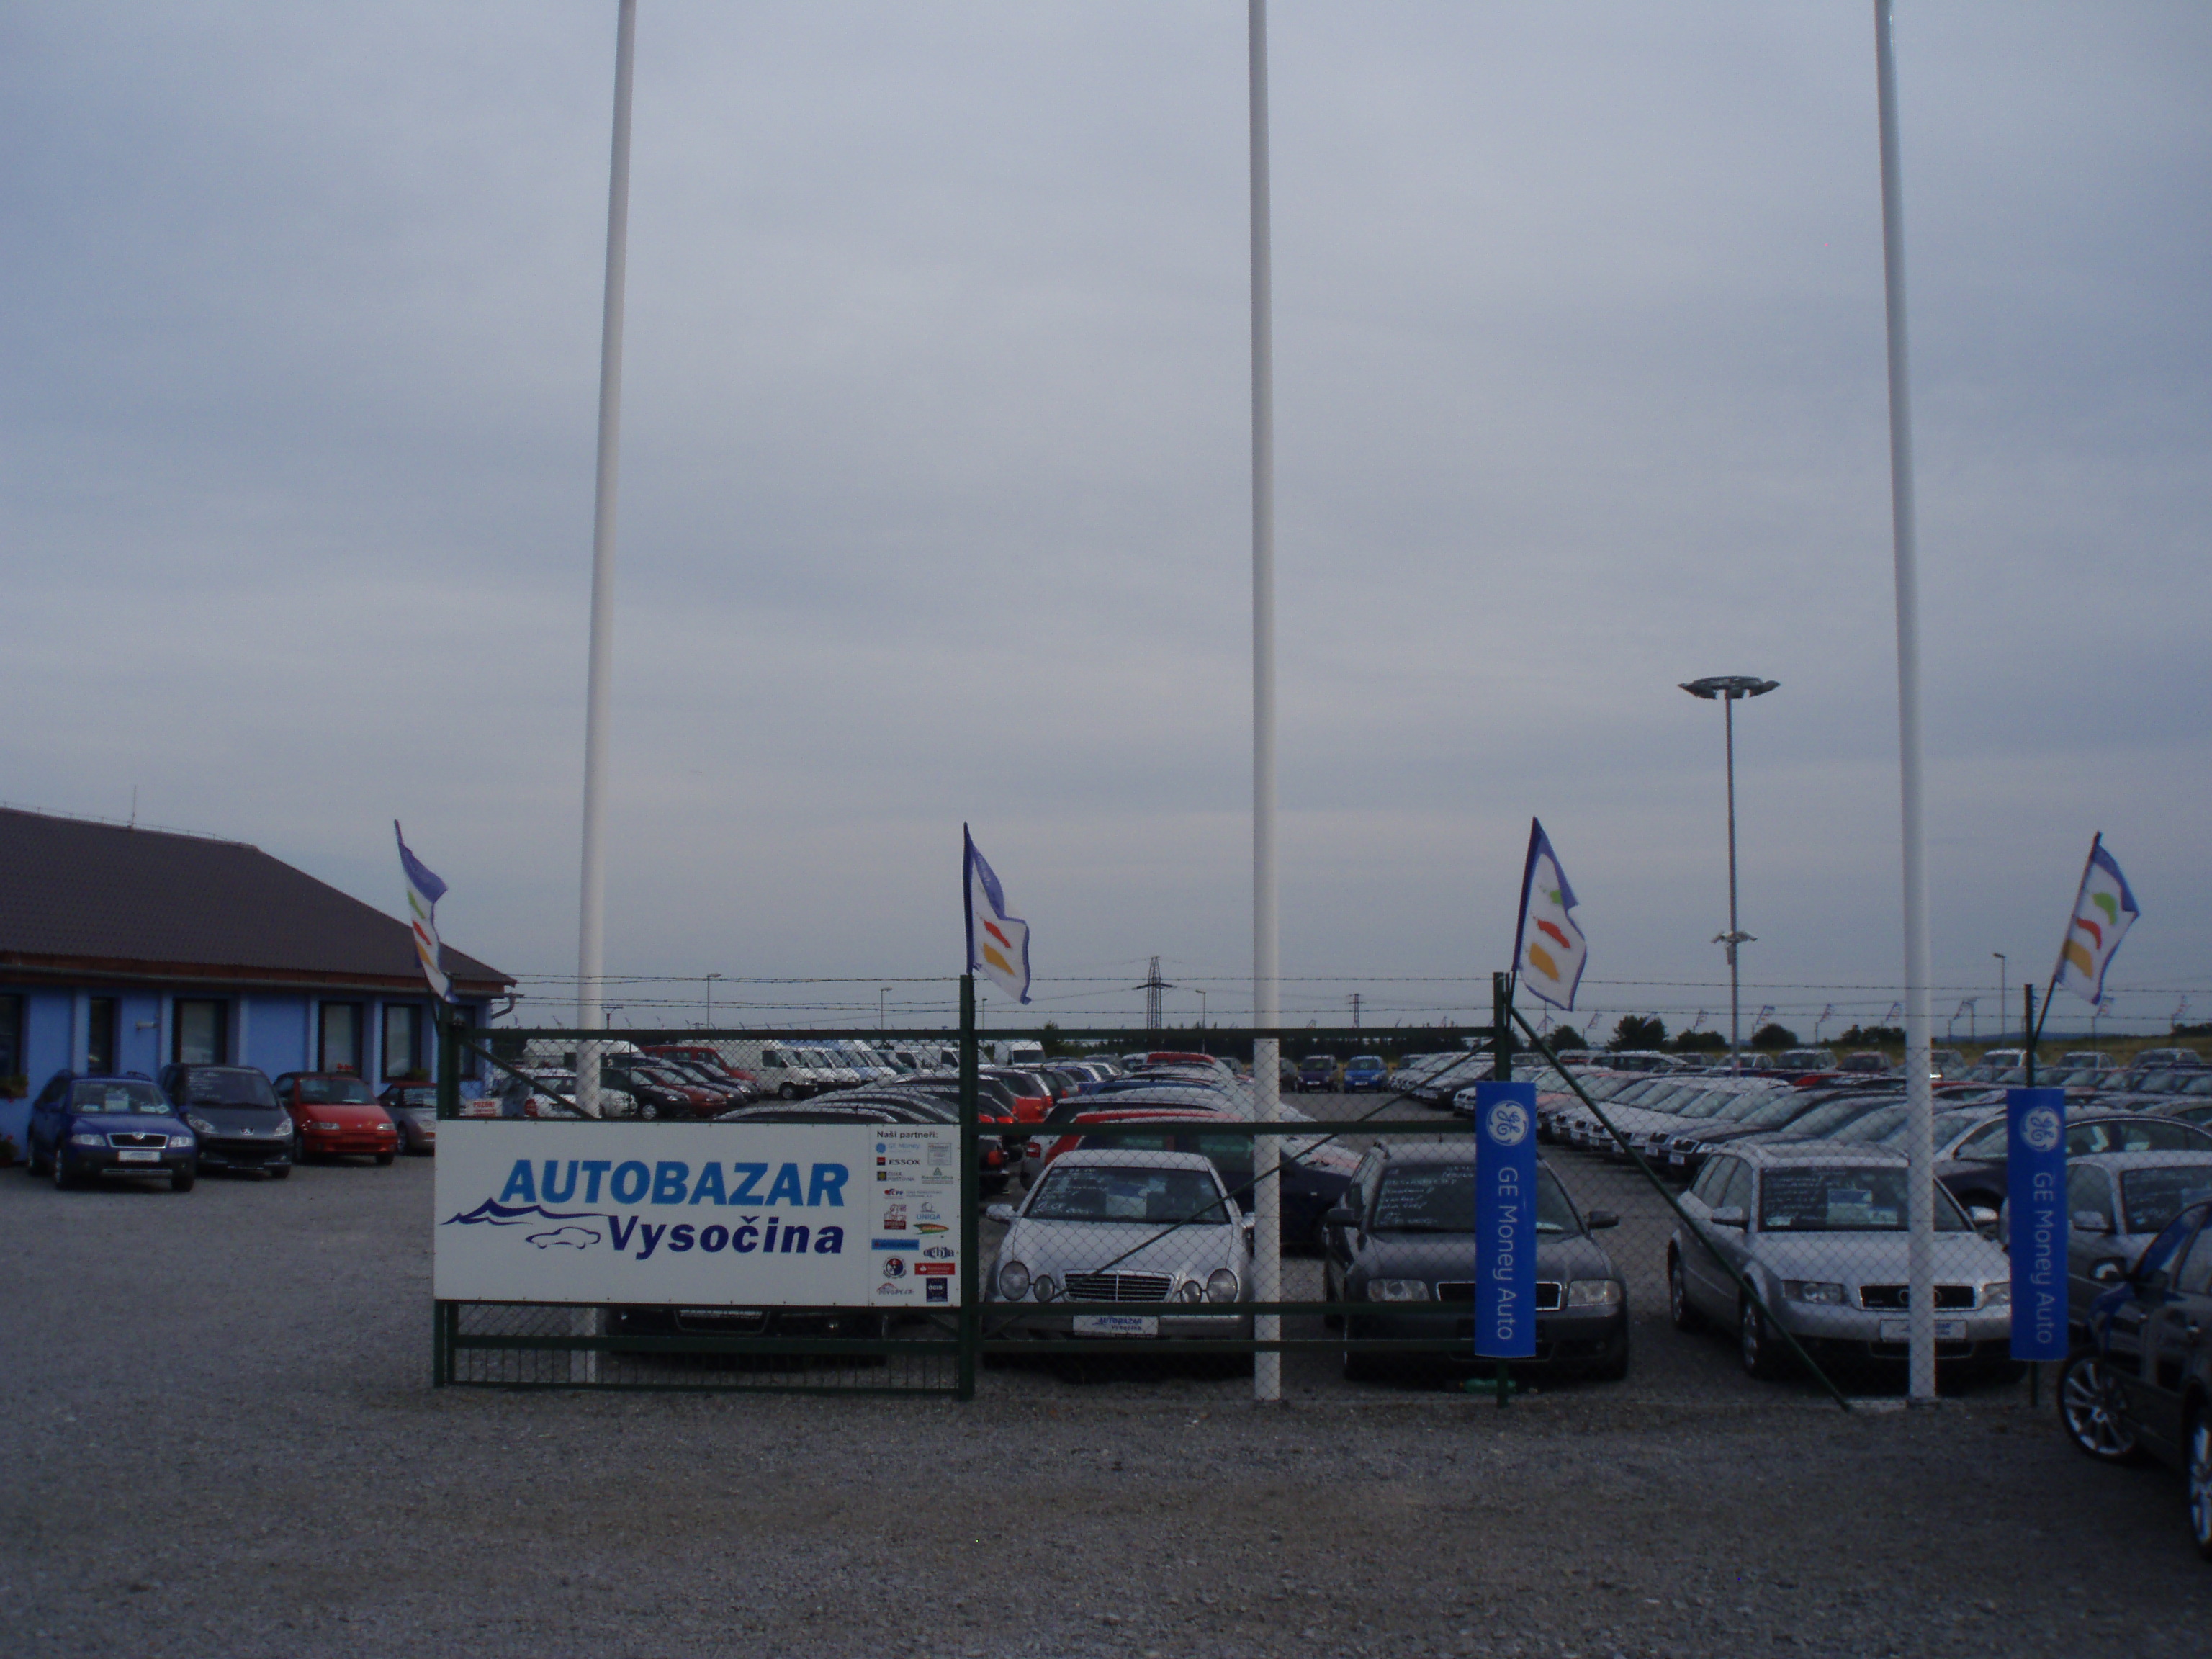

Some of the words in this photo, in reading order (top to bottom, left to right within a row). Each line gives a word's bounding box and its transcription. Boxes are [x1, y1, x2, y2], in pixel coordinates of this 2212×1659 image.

[500, 1160, 848, 1206] AUTOBAZAR
[1498, 1167, 1519, 1196] GE
[2033, 1172, 2054, 1202] GE
[610, 1215, 845, 1260] Vysočina
[1493, 1205, 1518, 1281] Money
[2031, 1210, 2054, 1285] Money
[1497, 1287, 1517, 1340] Auto
[2036, 1292, 2056, 1344] Auto
